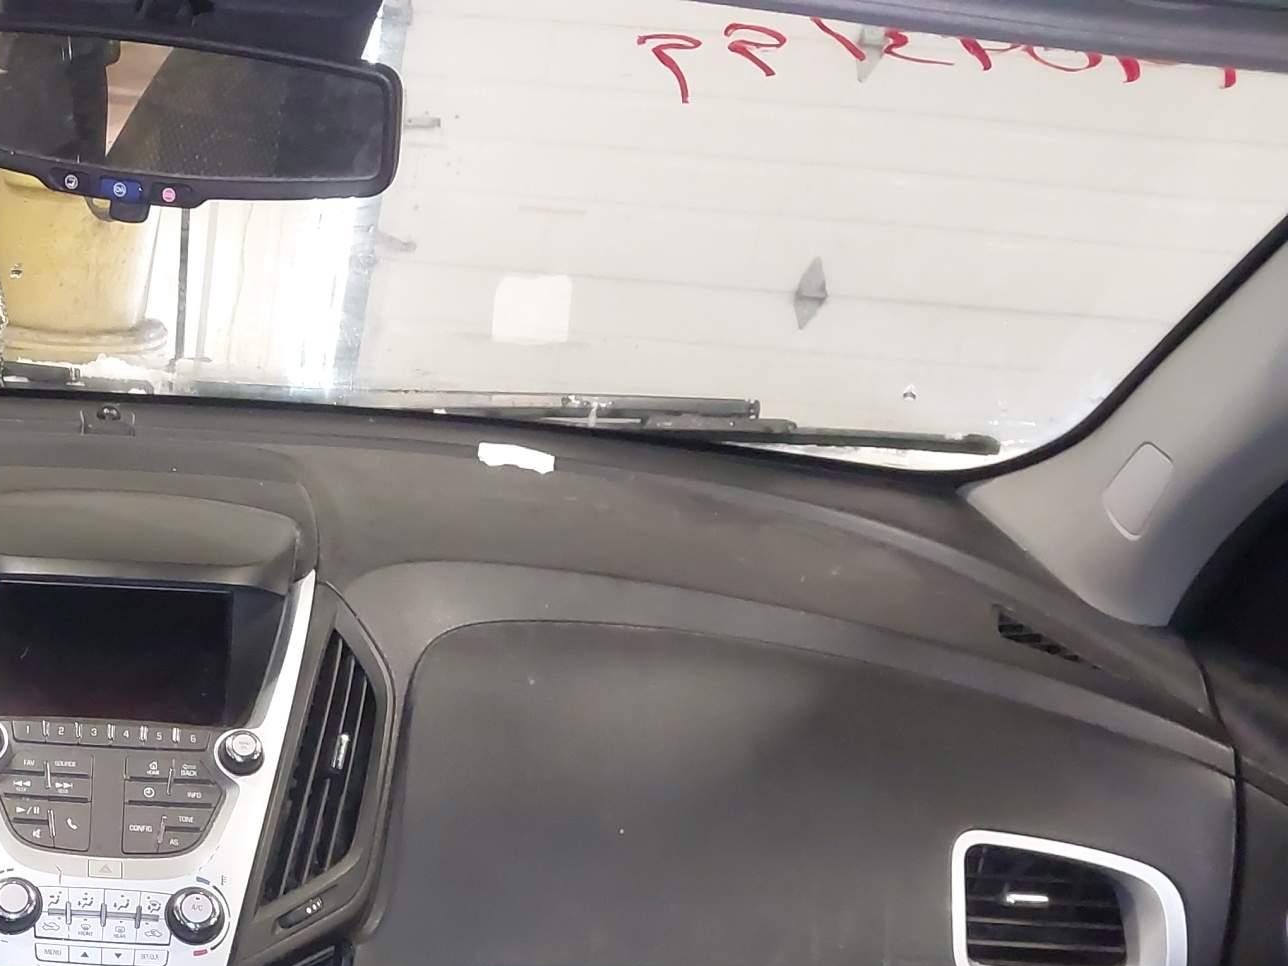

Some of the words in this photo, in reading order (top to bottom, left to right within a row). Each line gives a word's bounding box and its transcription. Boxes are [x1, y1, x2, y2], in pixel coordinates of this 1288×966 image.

[58, 726, 65, 735] 2
[91, 728, 98, 737] 3
[123, 729, 130, 738] 4
[156, 732, 163, 741] 5
[190, 734, 197, 743] 6
